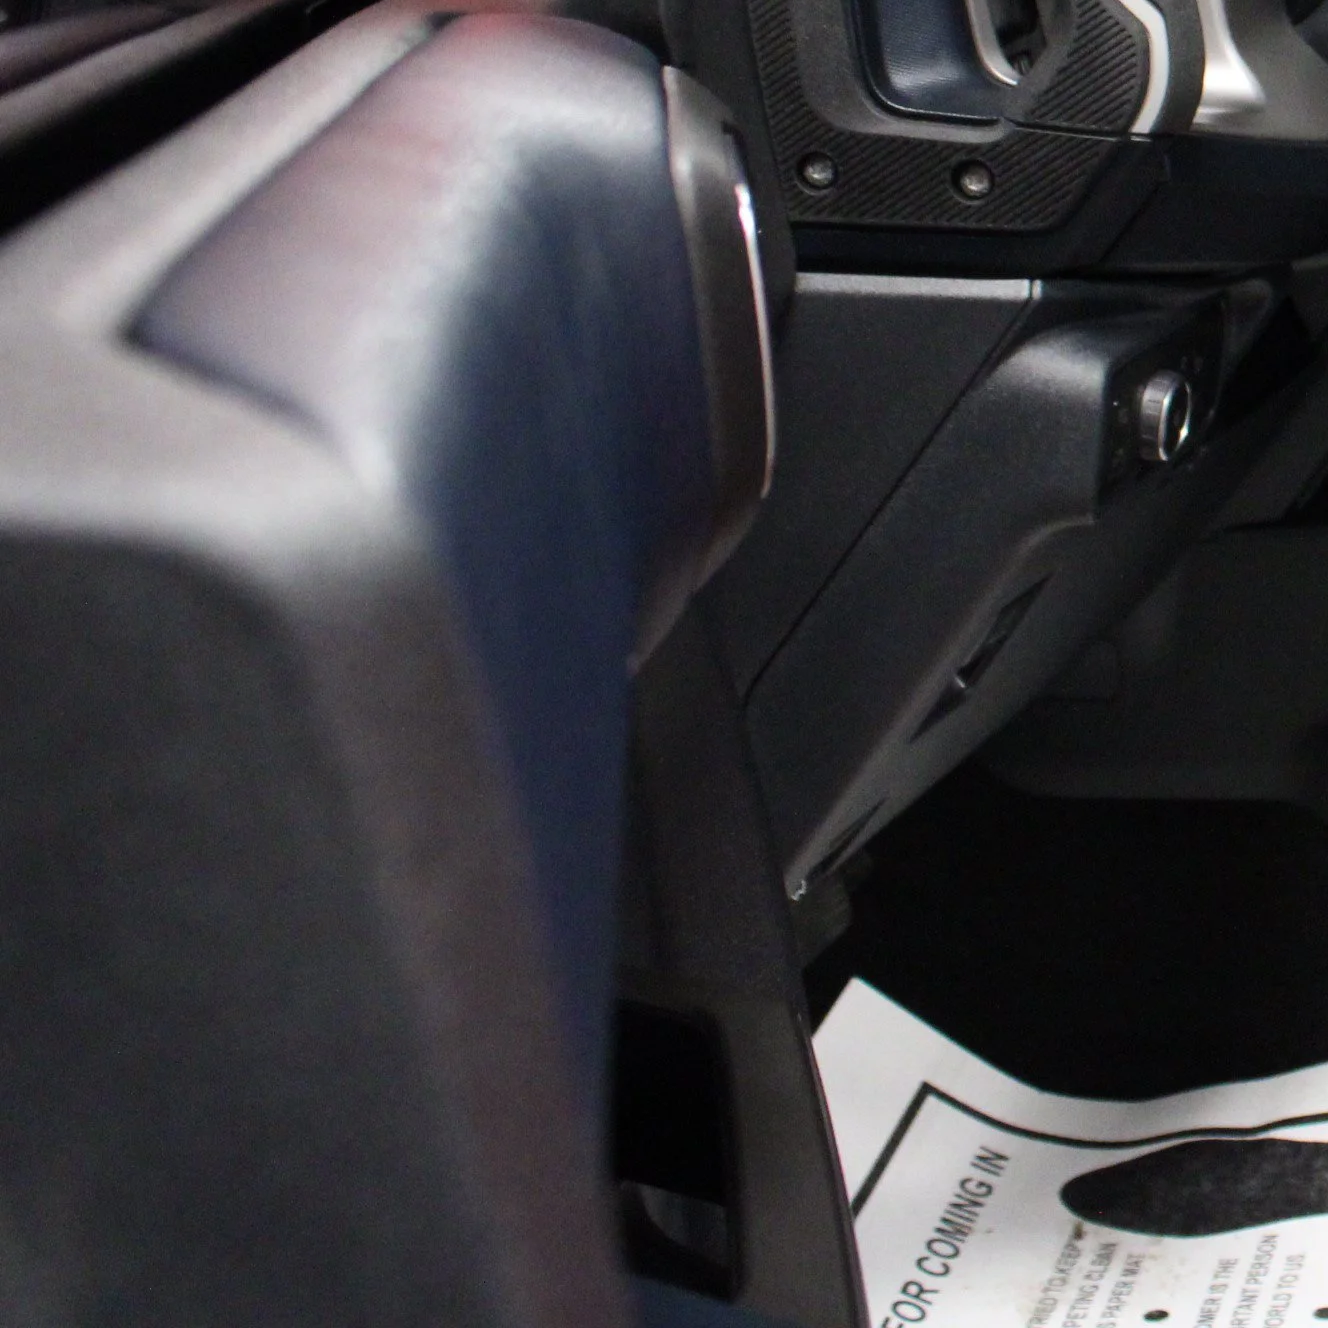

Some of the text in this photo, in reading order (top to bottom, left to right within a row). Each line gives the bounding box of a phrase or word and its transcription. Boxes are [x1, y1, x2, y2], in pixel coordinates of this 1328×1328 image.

[915, 1177, 993, 1278] COMING
[970, 1145, 1010, 1177] IN
[1054, 1242, 1081, 1276] KEEP
[1083, 1243, 1118, 1282] CLEAN
[1213, 1258, 1239, 1280] THE
[1041, 1277, 1068, 1293] TO
[1208, 1283, 1229, 1294] IS
[1229, 1234, 1279, 1328] RTANT PERSON
[1277, 1274, 1299, 1290] TO
[1101, 1280, 1135, 1319] PAPER
[1263, 1292, 1293, 1328] ORLD
